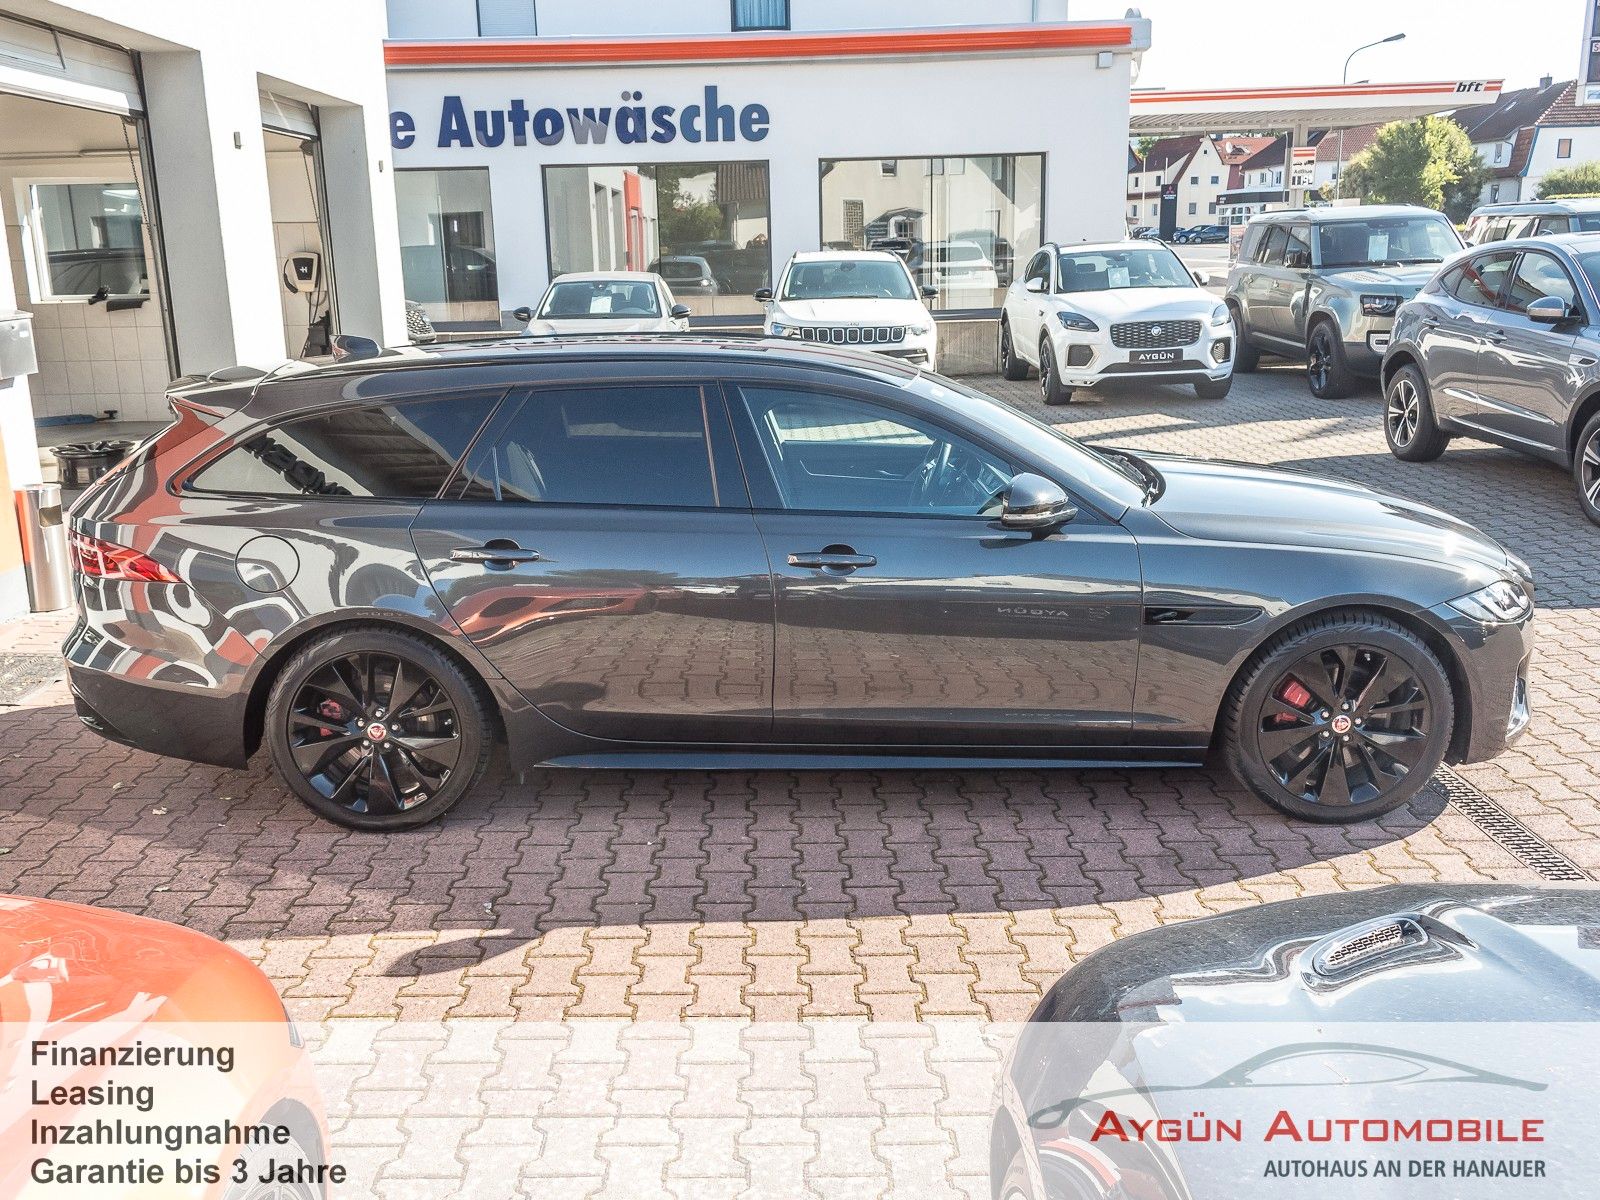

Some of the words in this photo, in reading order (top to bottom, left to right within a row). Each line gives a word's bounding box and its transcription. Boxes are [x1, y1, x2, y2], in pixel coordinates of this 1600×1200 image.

[1456, 81, 1483, 92] bft
[437, 85, 770, 148] Autowäsche
[1138, 352, 1174, 361] AYGÜN
